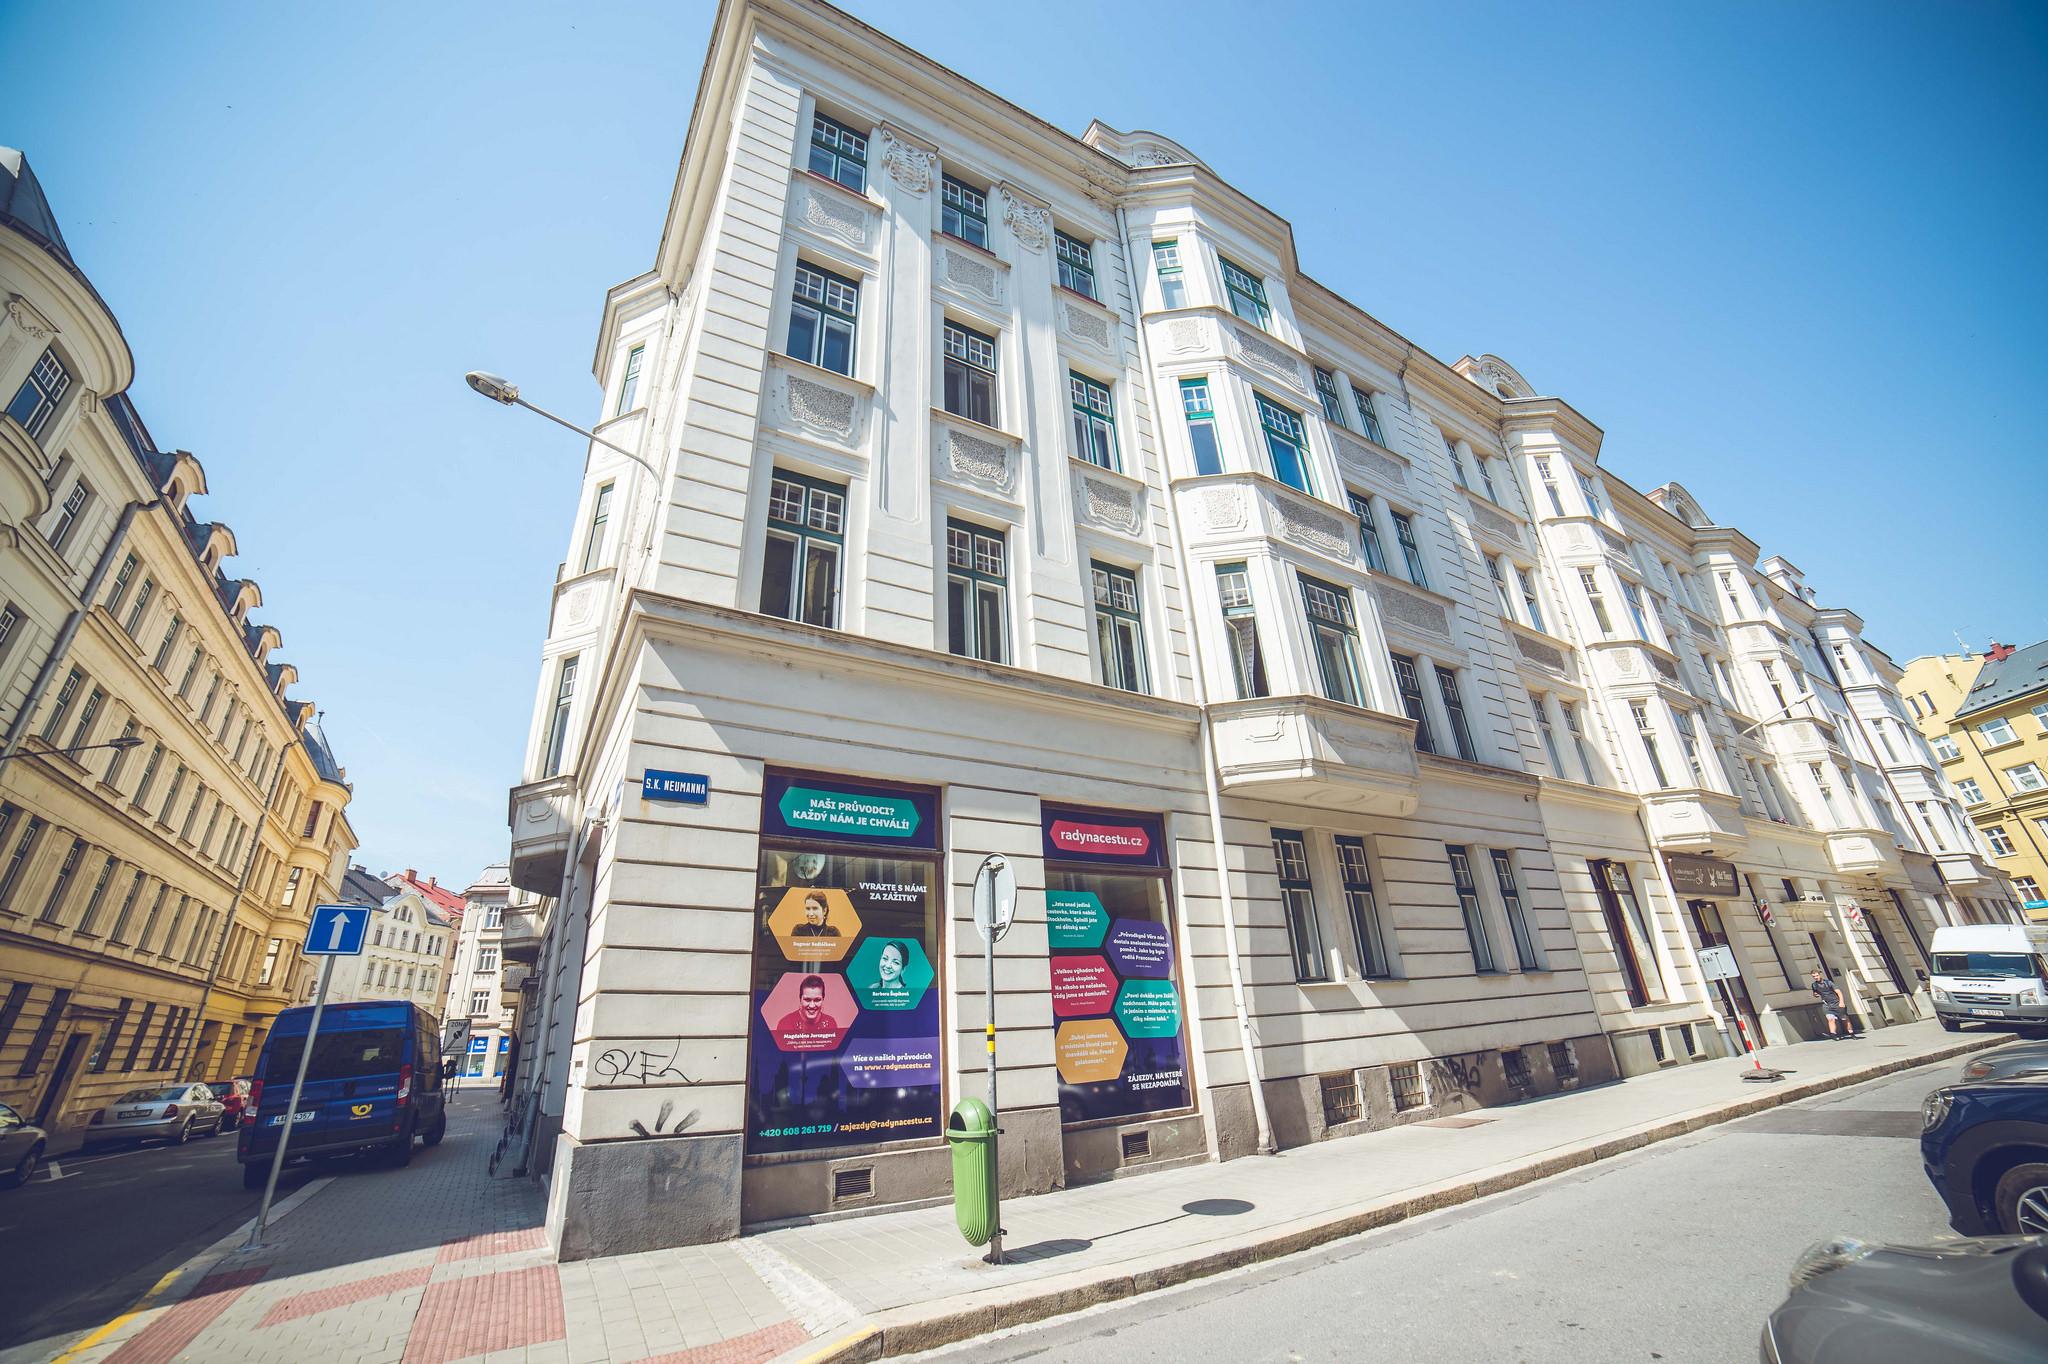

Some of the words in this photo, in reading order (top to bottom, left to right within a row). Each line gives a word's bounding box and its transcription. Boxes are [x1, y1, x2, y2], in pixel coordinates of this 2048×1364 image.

[645, 778, 660, 790] S.K.
[664, 780, 706, 794] NEUMANNA
[810, 798, 836, 810] NAŠI
[838, 800, 895, 816] PRŮVODCI?
[792, 810, 827, 822] KAŽDÝ
[830, 812, 854, 824] NÁM
[856, 816, 868, 826] JE
[870, 818, 910, 830] CHVÁLÍ!
[1060, 829, 1142, 846] radynacestu.cz
[859, 882, 896, 892] VYRAZTE
[904, 883, 928, 892] NÁMI
[882, 892, 918, 902] ZÁŽITKY
[897, 1052, 933, 1062] průvodcích
[864, 1063, 931, 1071] www.radynacestu.cz
[1128, 1074, 1155, 1082] ZÁJEZDY,
[1165, 1069, 1183, 1078] KTERÉ
[1141, 1077, 1180, 1090] NEZAPOMÍNÁ
[759, 1128, 781, 1137] +420
[783, 1126, 800, 1136] 608
[801, 1126, 817, 1134] 261
[818, 1124, 832, 1133] 719
[834, 1123, 839, 1132] /
[840, 1117, 933, 1131] zajezdy@radynacestu.cz
